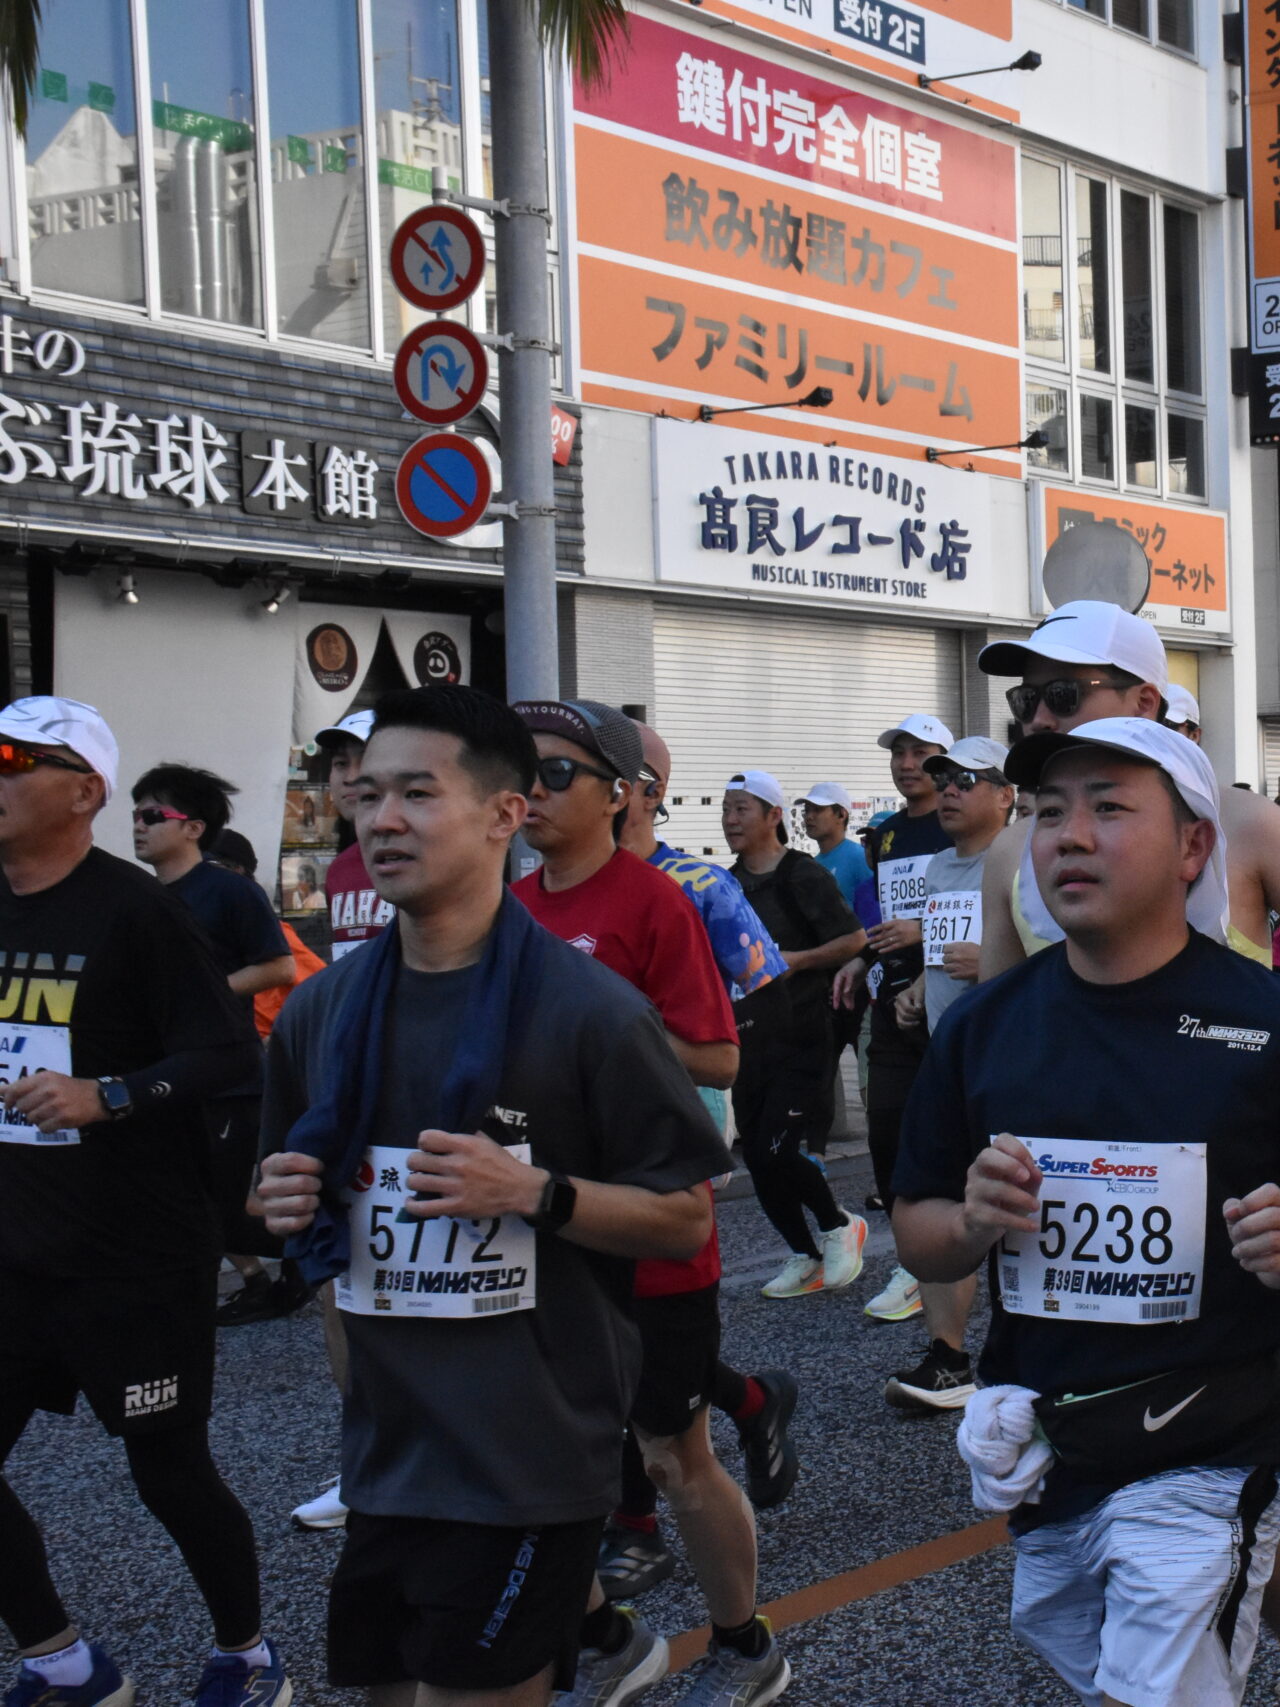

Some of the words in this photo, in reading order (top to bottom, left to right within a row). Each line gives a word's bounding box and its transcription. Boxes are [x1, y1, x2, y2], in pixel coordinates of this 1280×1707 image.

[888, 14, 920, 54] 2F
[675, 52, 943, 202] 鍵付完全個室
[661, 172, 958, 312] 飲み放題カフェ
[645, 296, 973, 422] ファミリールーム
[724, 450, 819, 485] TAKARA
[828, 455, 927, 514] RECORDS
[752, 563, 808, 586] MUSICAL
[812, 570, 890, 595] INSTRUMENT
[891, 579, 927, 599] STORE
[891, 877, 926, 901] 5088
[930, 916, 972, 941] 5617
[1038, 1200, 1174, 1265] 5238
